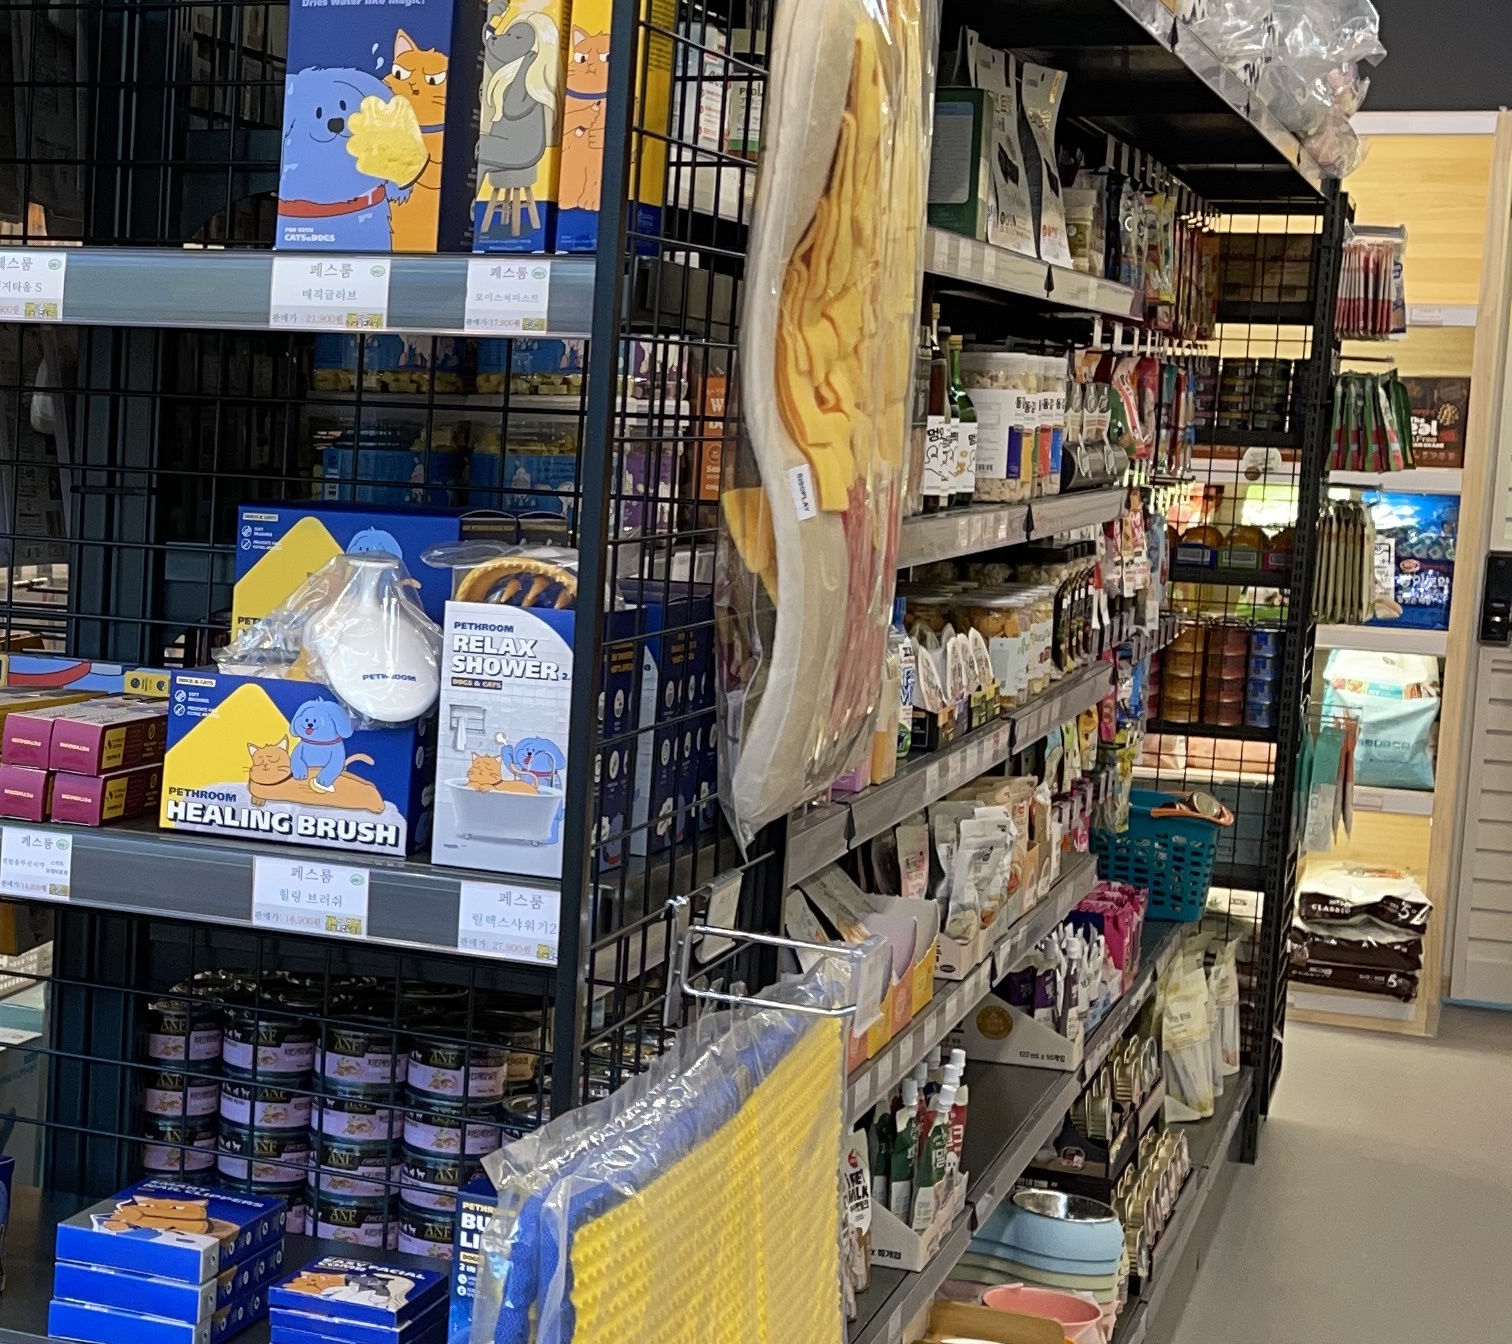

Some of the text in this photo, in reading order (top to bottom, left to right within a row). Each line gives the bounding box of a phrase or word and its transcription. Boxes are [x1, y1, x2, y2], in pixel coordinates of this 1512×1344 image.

[309, 262, 354, 279] 페스룸
[490, 266, 528, 279] 페스룸
[454, 621, 514, 633] PETHROOM
[452, 634, 537, 658] RELAX
[451, 655, 559, 680] SHOWER
[168, 786, 237, 803] PETHROOM
[166, 800, 398, 846] HEALING BRUSH
[21, 835, 53, 849] 페스룸
[290, 866, 333, 883] 페스룸
[307, 894, 343, 907] 브러쉬
[498, 891, 544, 910] 페스룸
[335, 1035, 361, 1055] ANF
[329, 1208, 356, 1225] ANF
[424, 1224, 453, 1240] ANF
